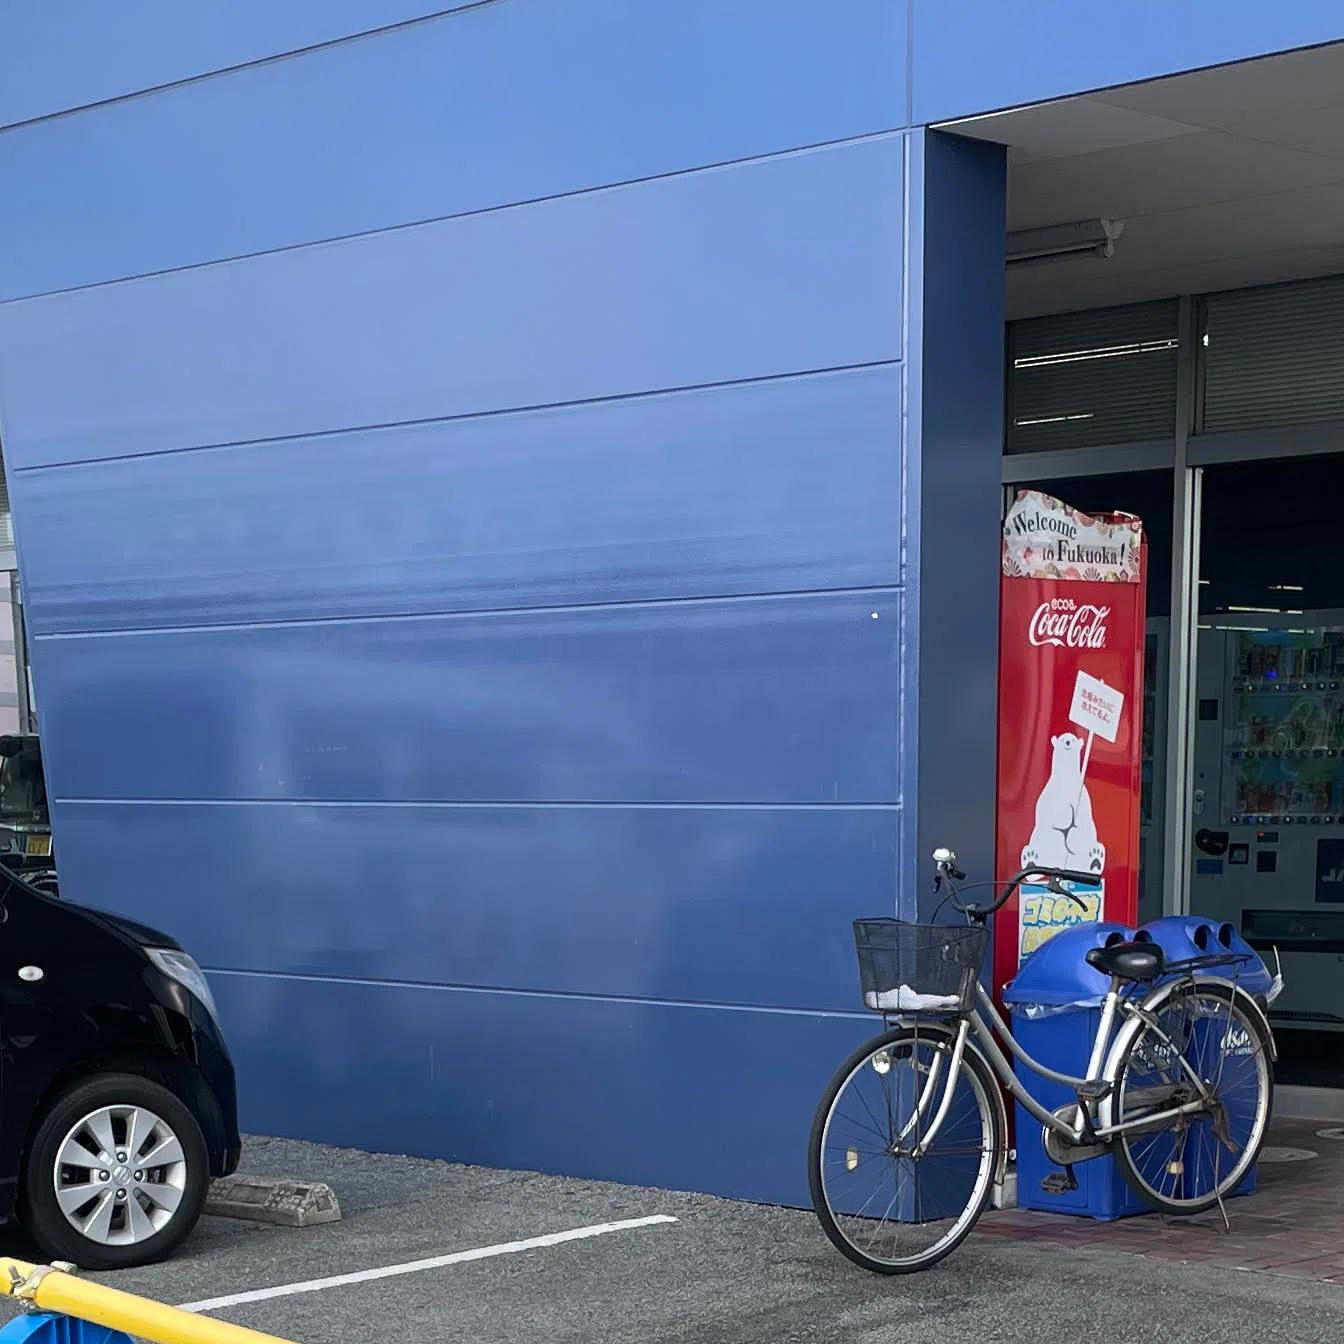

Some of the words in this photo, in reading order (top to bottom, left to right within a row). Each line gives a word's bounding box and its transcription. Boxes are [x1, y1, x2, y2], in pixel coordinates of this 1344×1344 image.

[1012, 510, 1077, 540] Welcome
[1042, 546, 1055, 561] to
[1056, 540, 1125, 567] Fukuoka!
[1029, 602, 1111, 649] Coca-Cola
